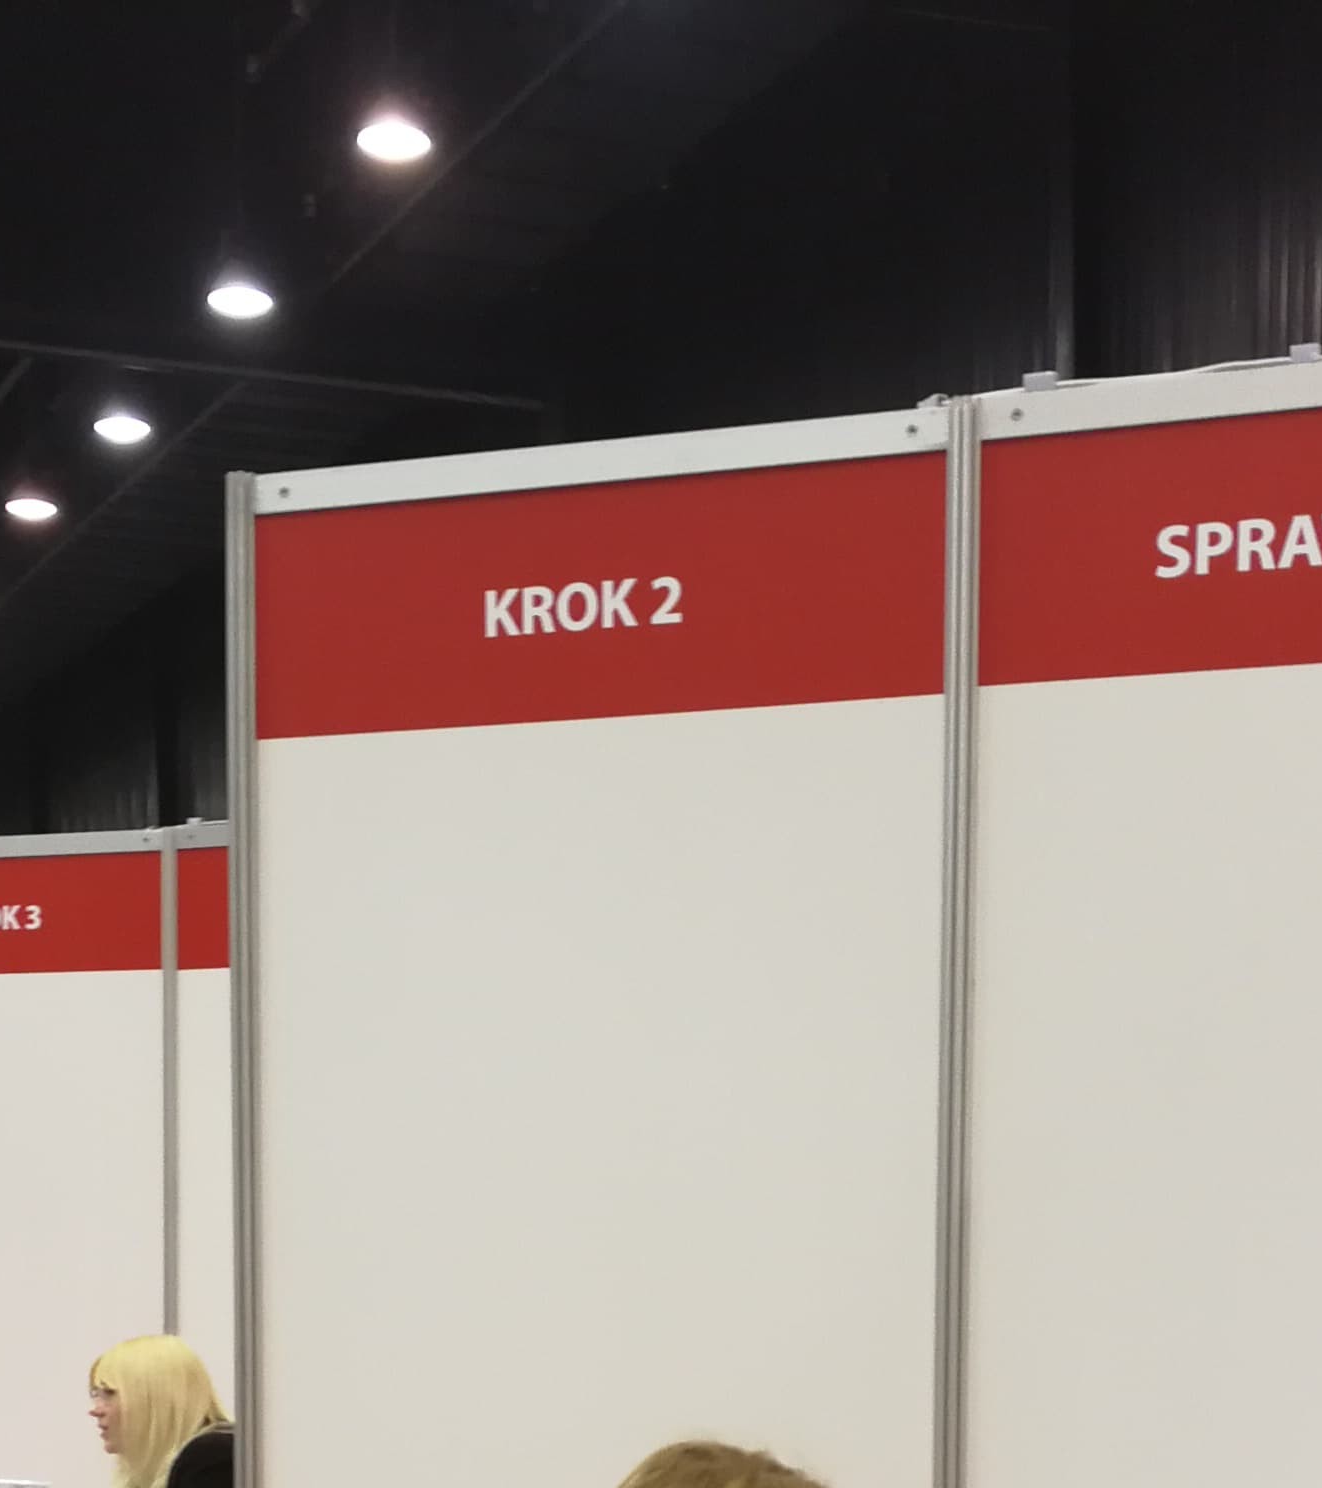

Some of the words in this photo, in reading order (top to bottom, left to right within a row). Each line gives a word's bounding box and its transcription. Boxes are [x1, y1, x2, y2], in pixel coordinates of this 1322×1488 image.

[484, 577, 638, 638] KROK
[650, 575, 683, 625] 2
[24, 904, 43, 930] 3
